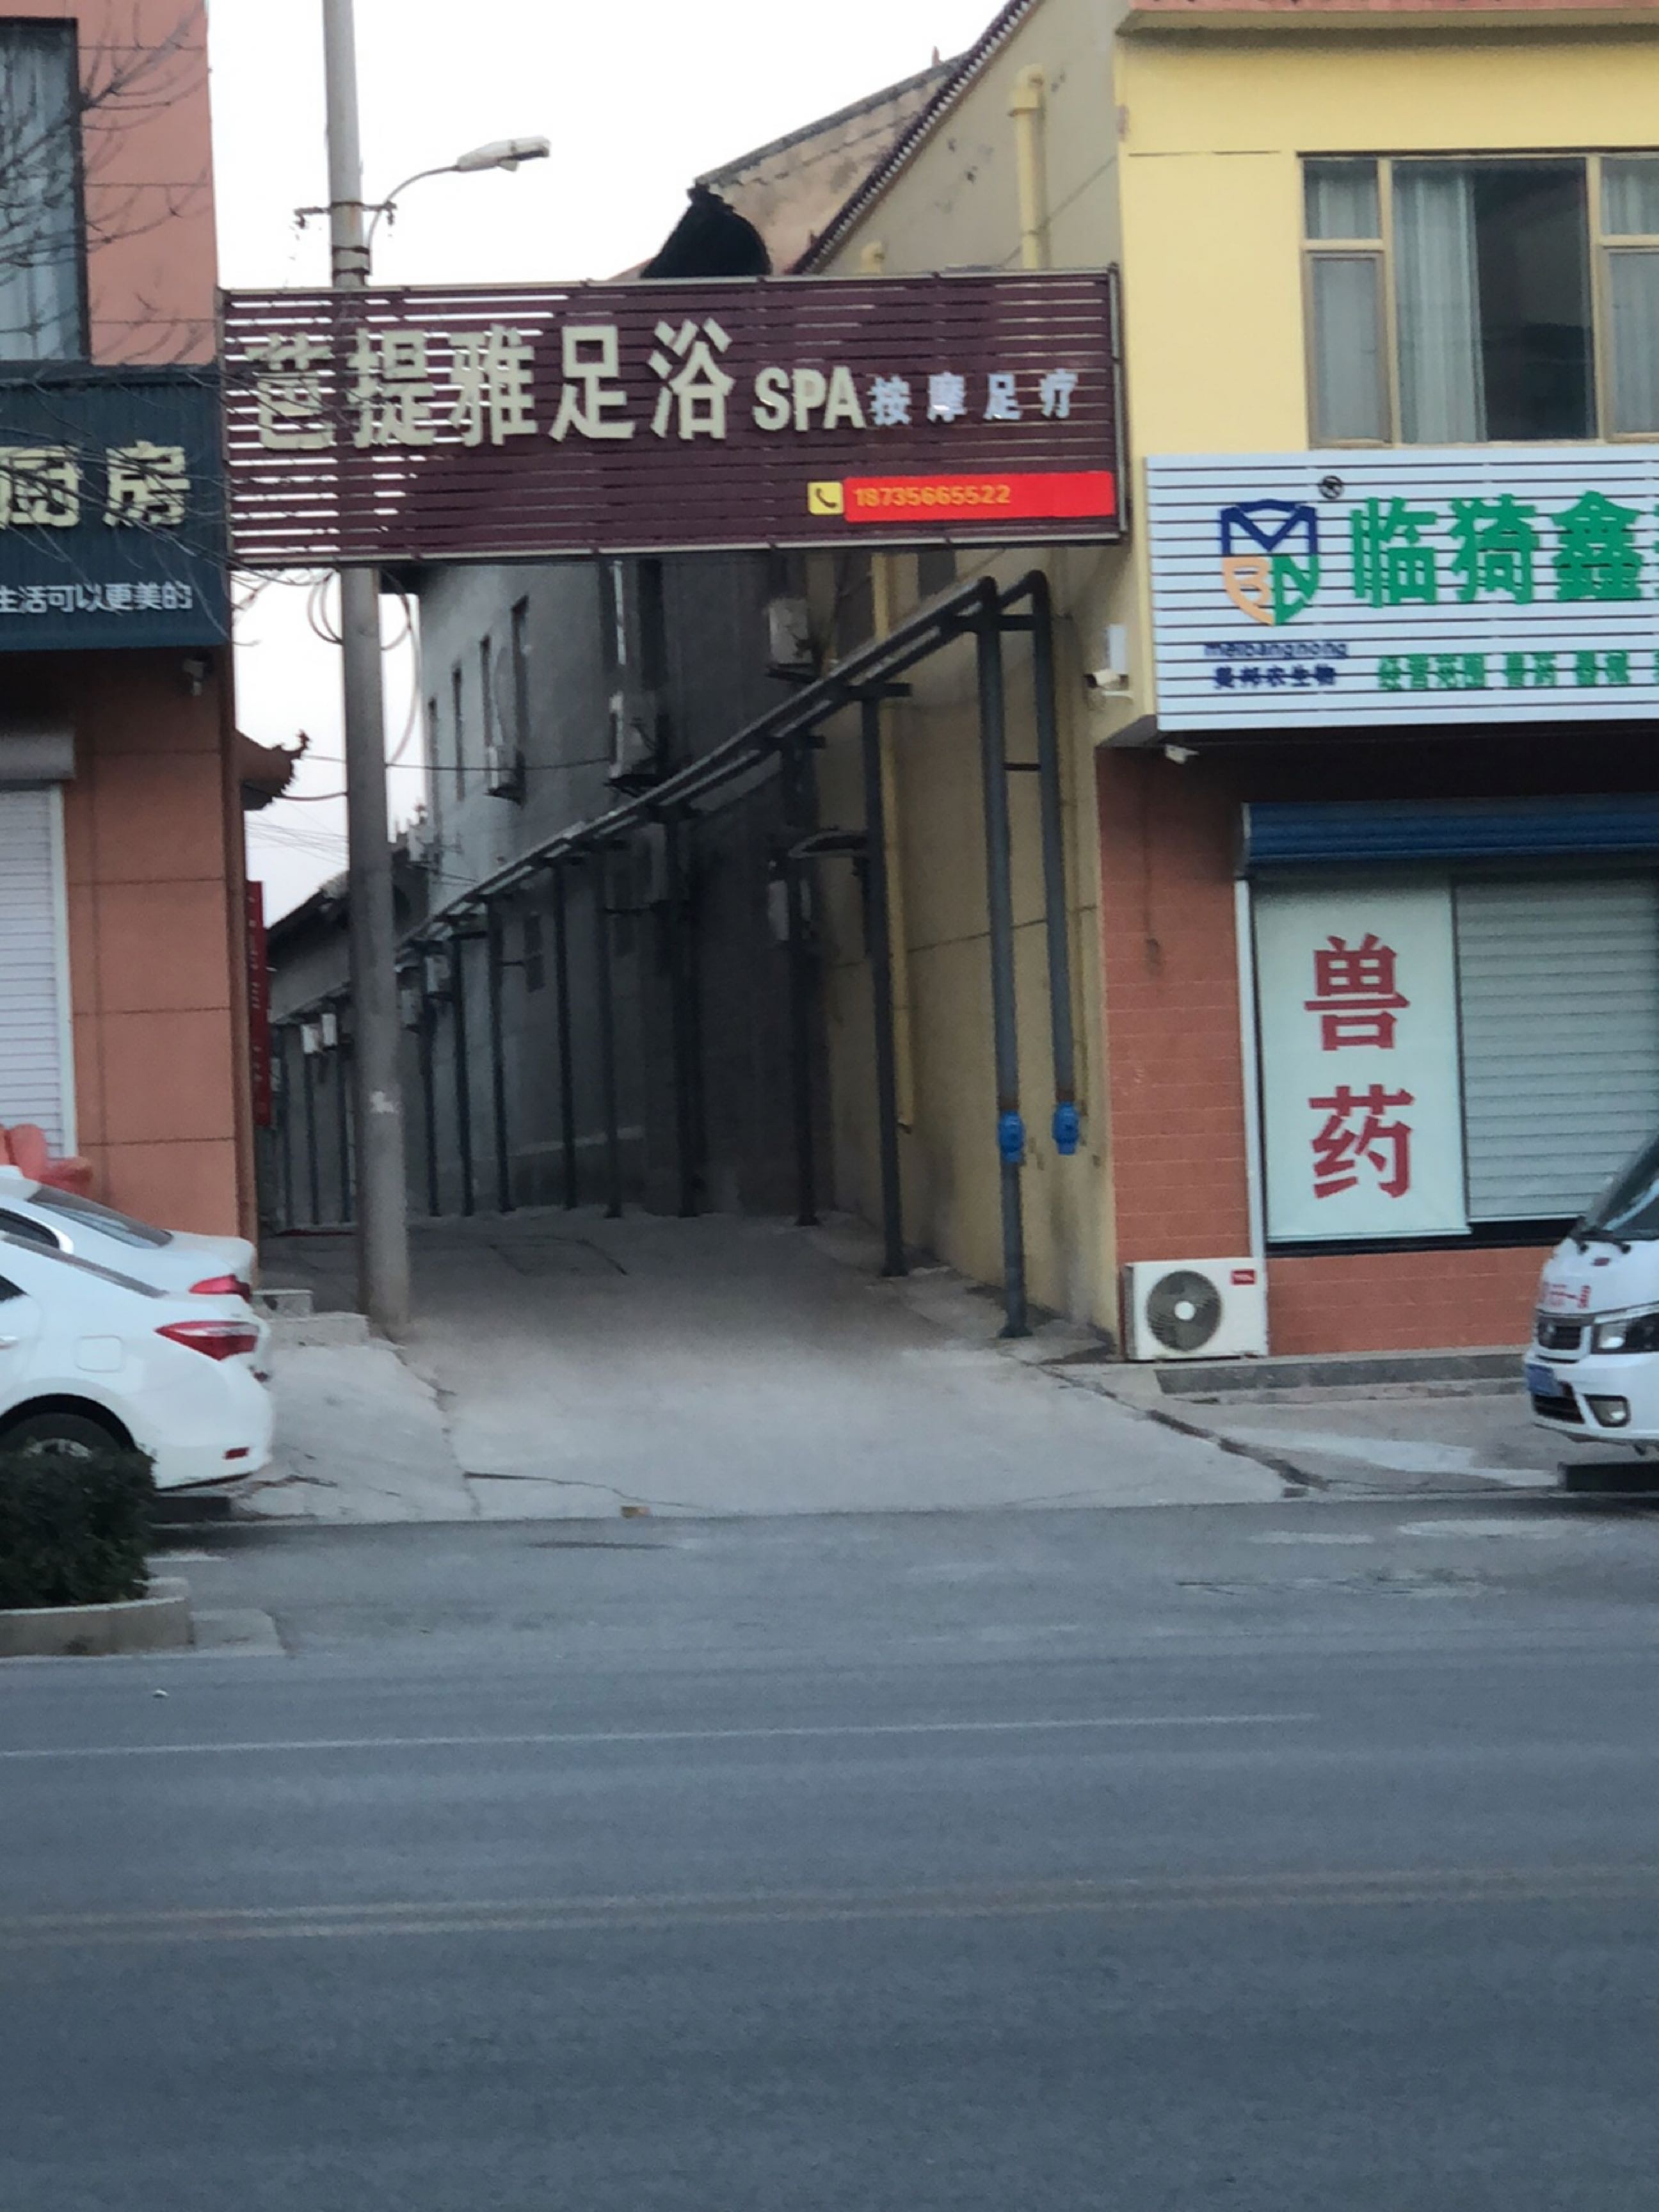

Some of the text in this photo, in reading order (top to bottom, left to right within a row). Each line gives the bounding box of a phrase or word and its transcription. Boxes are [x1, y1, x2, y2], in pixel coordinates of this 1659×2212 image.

[751, 366, 867, 432] SPA
[869, 368, 1078, 426] 按摩足疗
[853, 484, 1011, 508] 18735665522
[1350, 490, 1659, 608] 临猗鑫
[0, 580, 193, 614] 生活可以更美的
[1303, 933, 1415, 1199] 兽药
